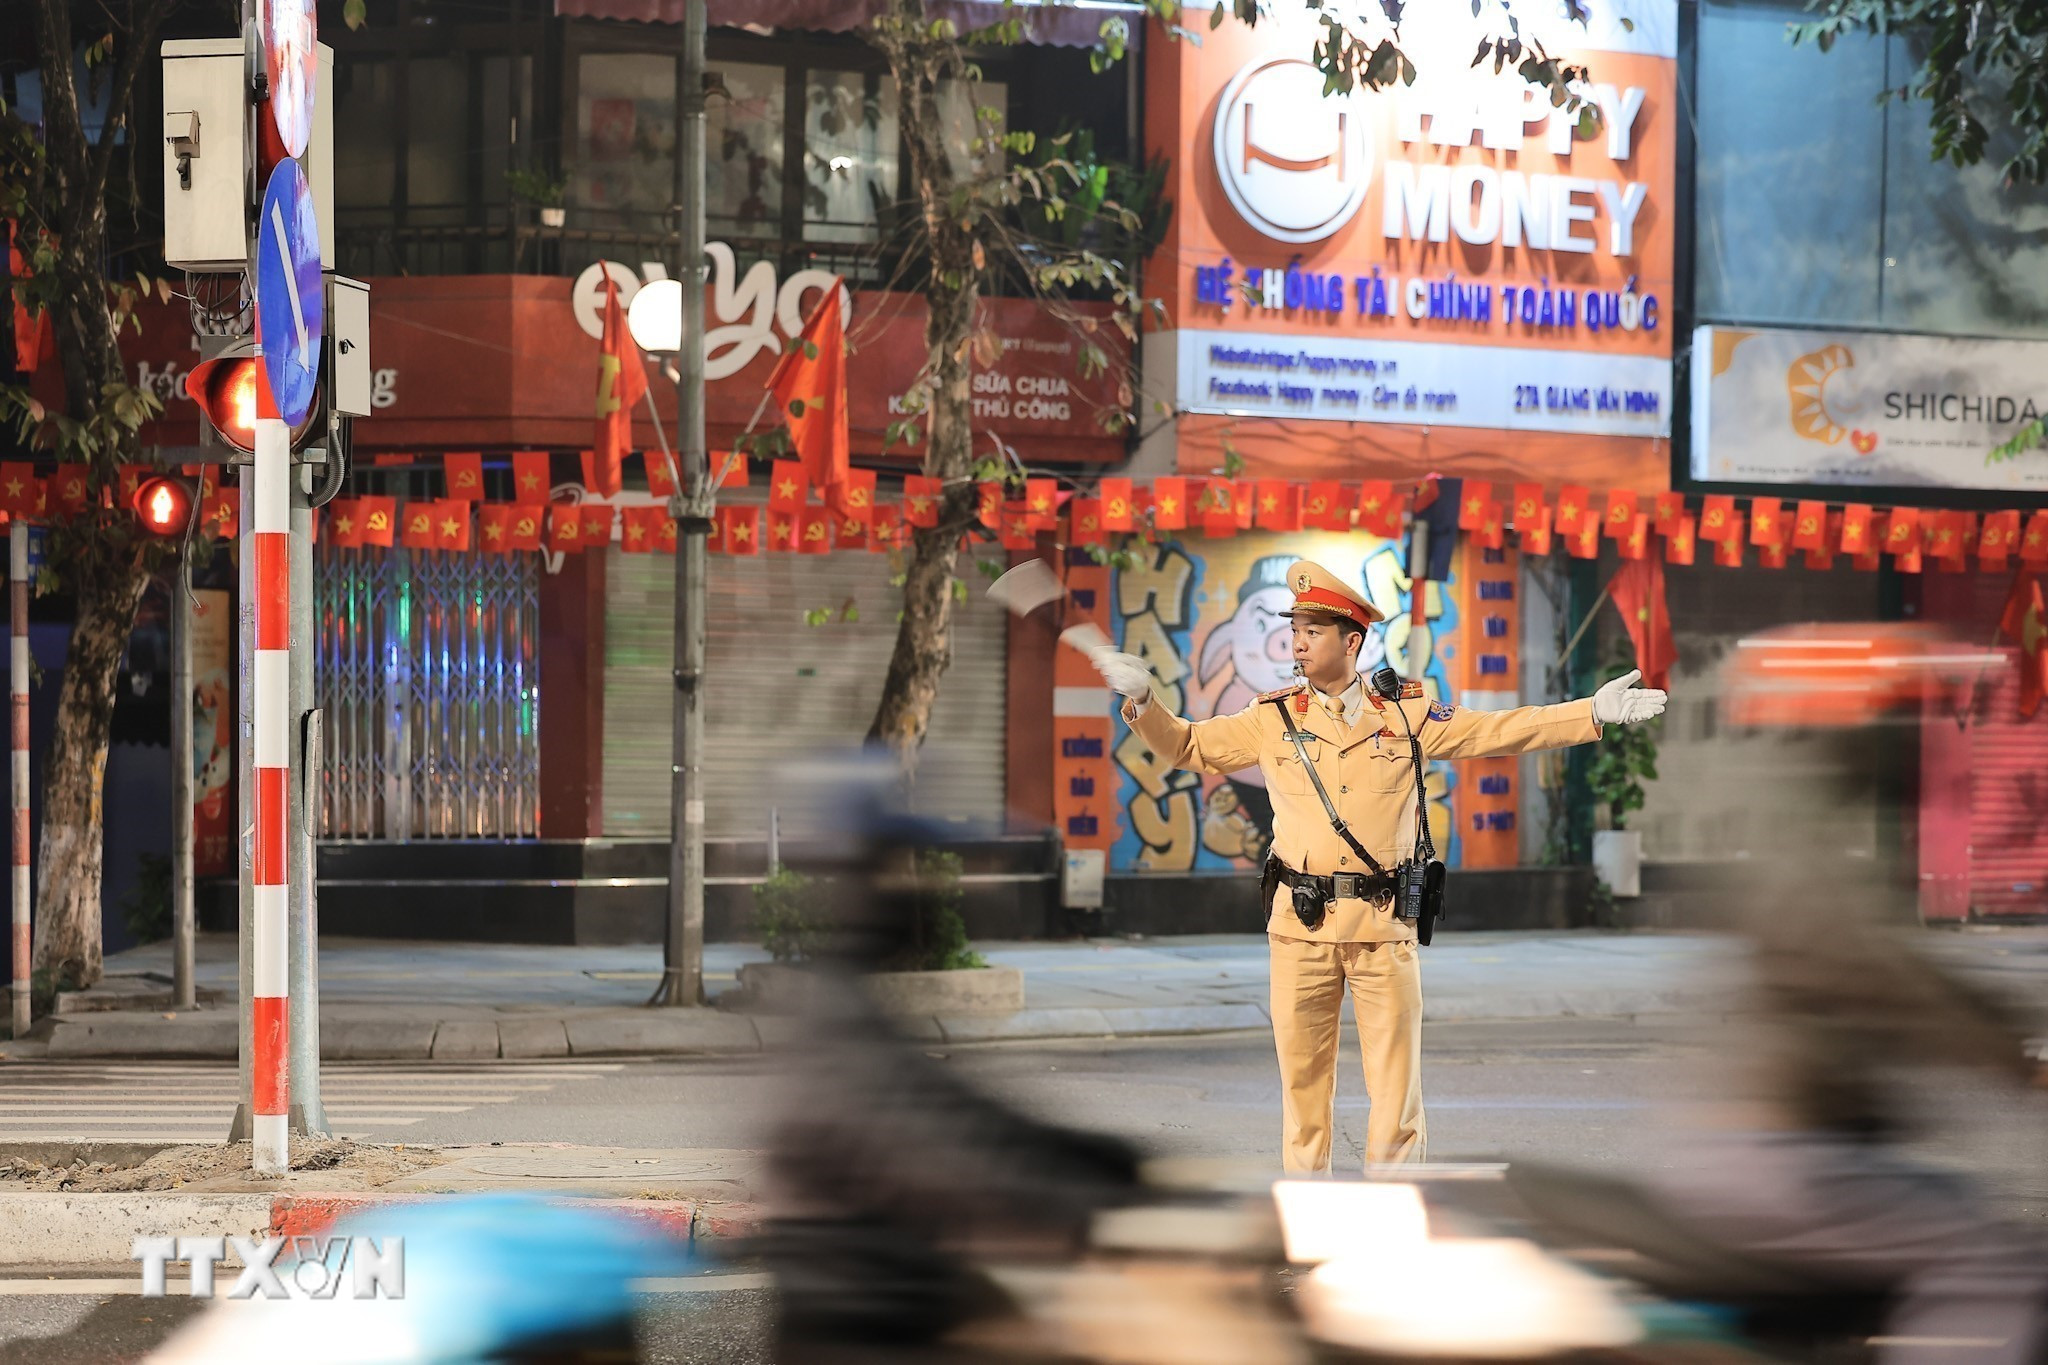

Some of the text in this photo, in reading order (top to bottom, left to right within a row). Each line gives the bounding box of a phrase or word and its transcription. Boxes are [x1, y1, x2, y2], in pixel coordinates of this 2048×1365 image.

[1382, 160, 1648, 257] MONEY
[1355, 264, 1399, 318] TÀI
[1405, 271, 1491, 322] CHÍNH
[1500, 276, 1576, 328] TOÀN
[1582, 275, 1658, 333] QUỐC
[1015, 376, 1069, 396] CHUA
[1014, 398, 1071, 420] CÔNG
[1885, 391, 2043, 423] SHICHIDA
